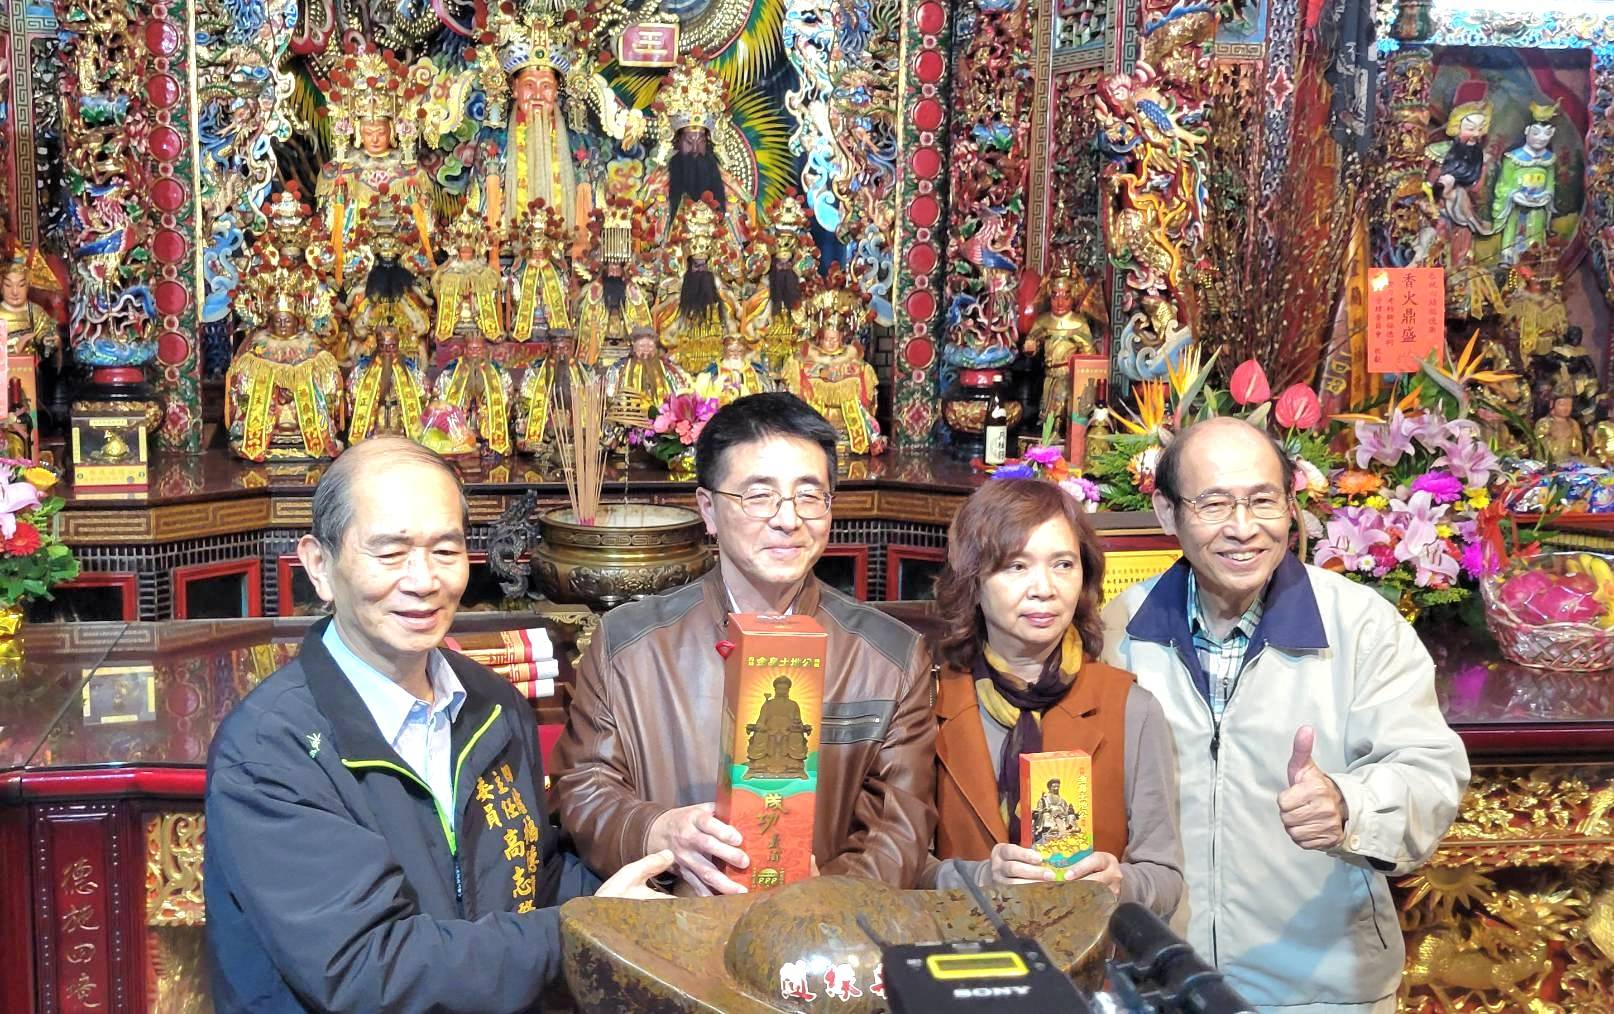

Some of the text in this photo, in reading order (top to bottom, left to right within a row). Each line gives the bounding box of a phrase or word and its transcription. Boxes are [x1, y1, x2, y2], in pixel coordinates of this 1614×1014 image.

[1401, 272, 1418, 343] 香火鼎盛
[476, 776, 503, 830] 委員
[953, 986, 1032, 998] SONY
